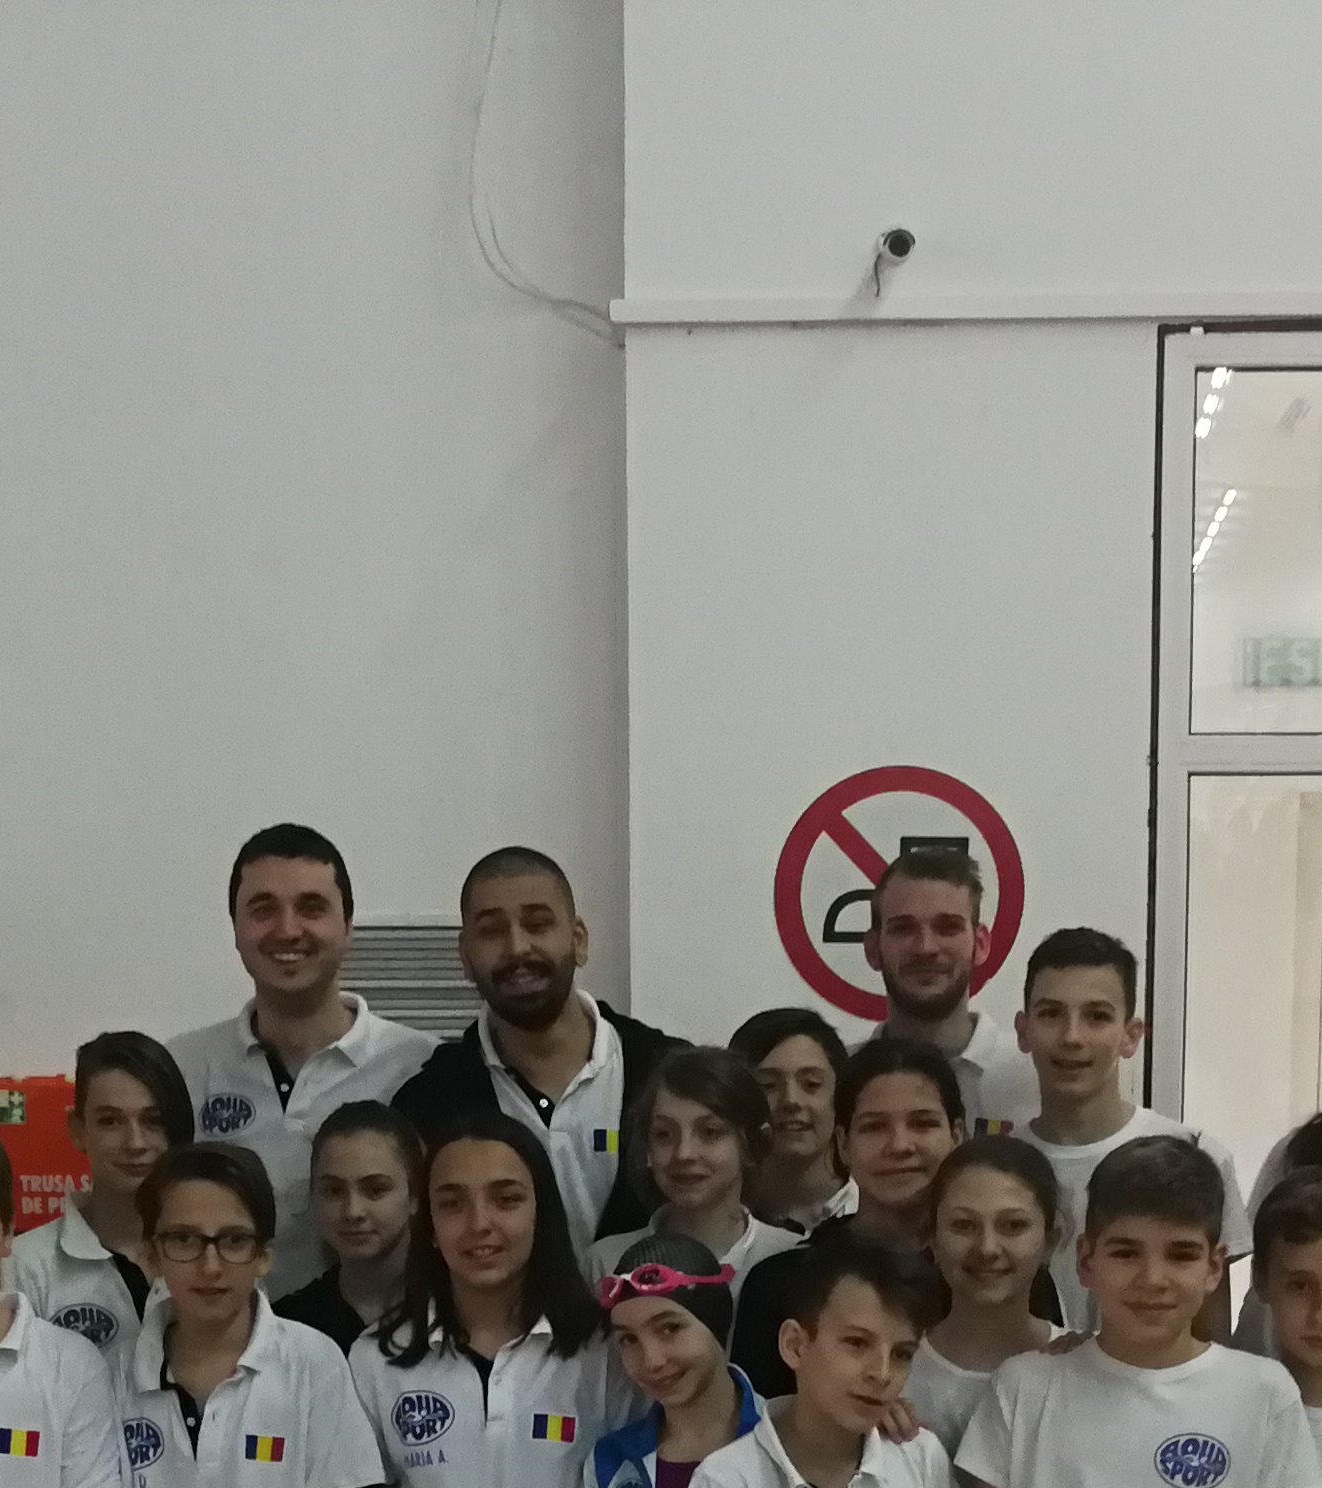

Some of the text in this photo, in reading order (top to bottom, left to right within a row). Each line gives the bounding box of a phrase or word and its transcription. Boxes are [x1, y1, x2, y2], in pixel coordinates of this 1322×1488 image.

[19, 1175, 76, 1193] TRUSA
[21, 1197, 43, 1214] DE
[1159, 1438, 1226, 1473] AQUA
[1159, 1458, 1220, 1487] SPORT
